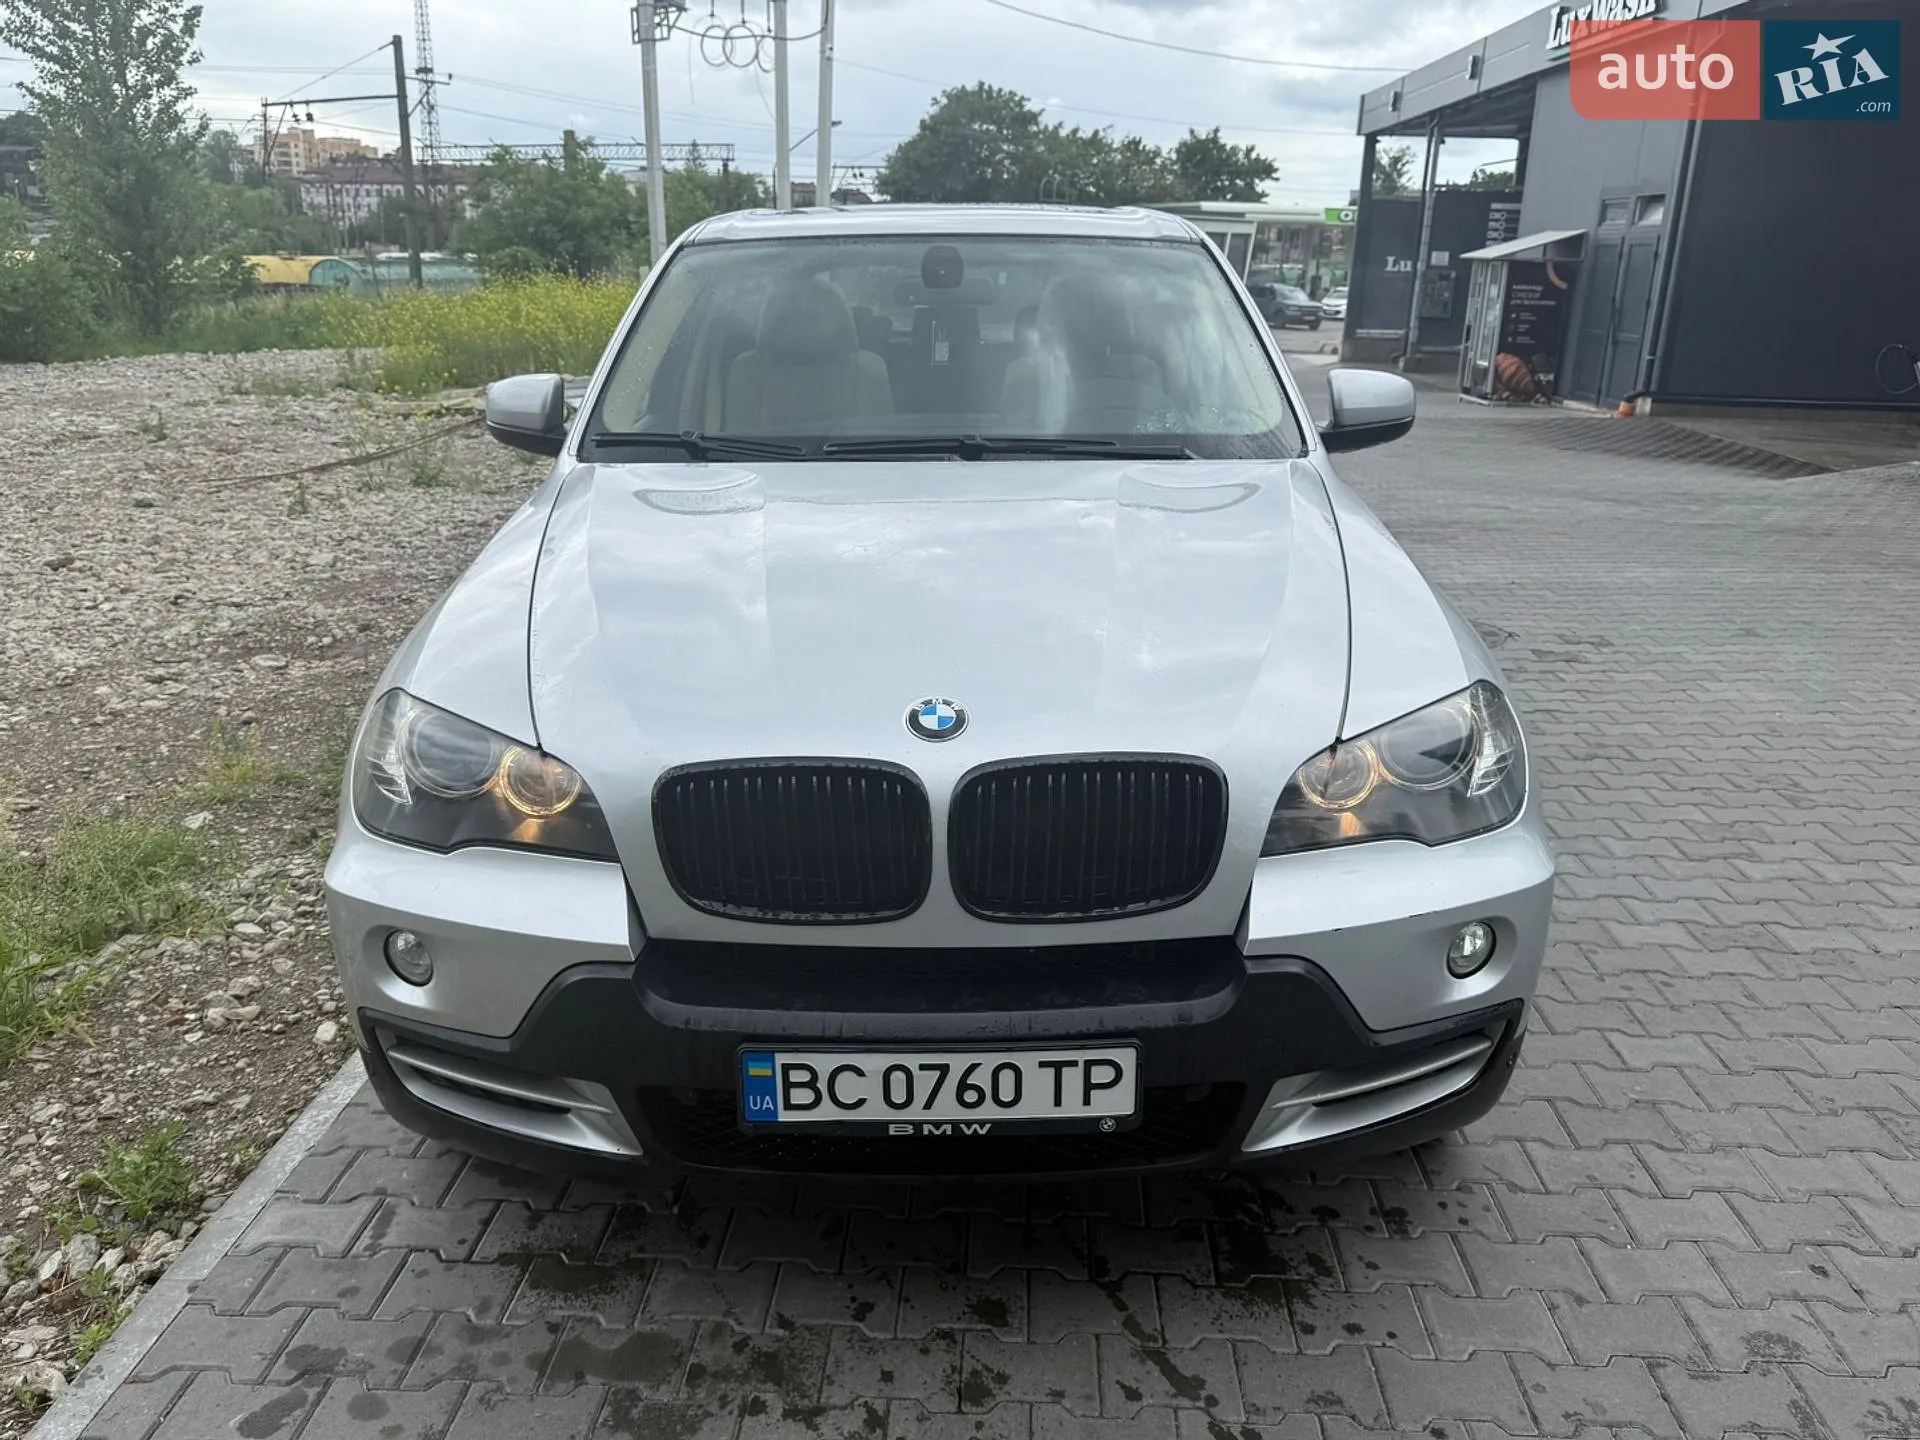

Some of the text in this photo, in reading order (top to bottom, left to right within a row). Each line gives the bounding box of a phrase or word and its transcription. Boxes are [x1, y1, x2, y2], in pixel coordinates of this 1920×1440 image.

[1384, 255, 1413, 272] Lu
[780, 1058, 1124, 1112] BC 0760 TP
[749, 1095, 775, 1111] UA
[887, 1122, 992, 1136] BMW
